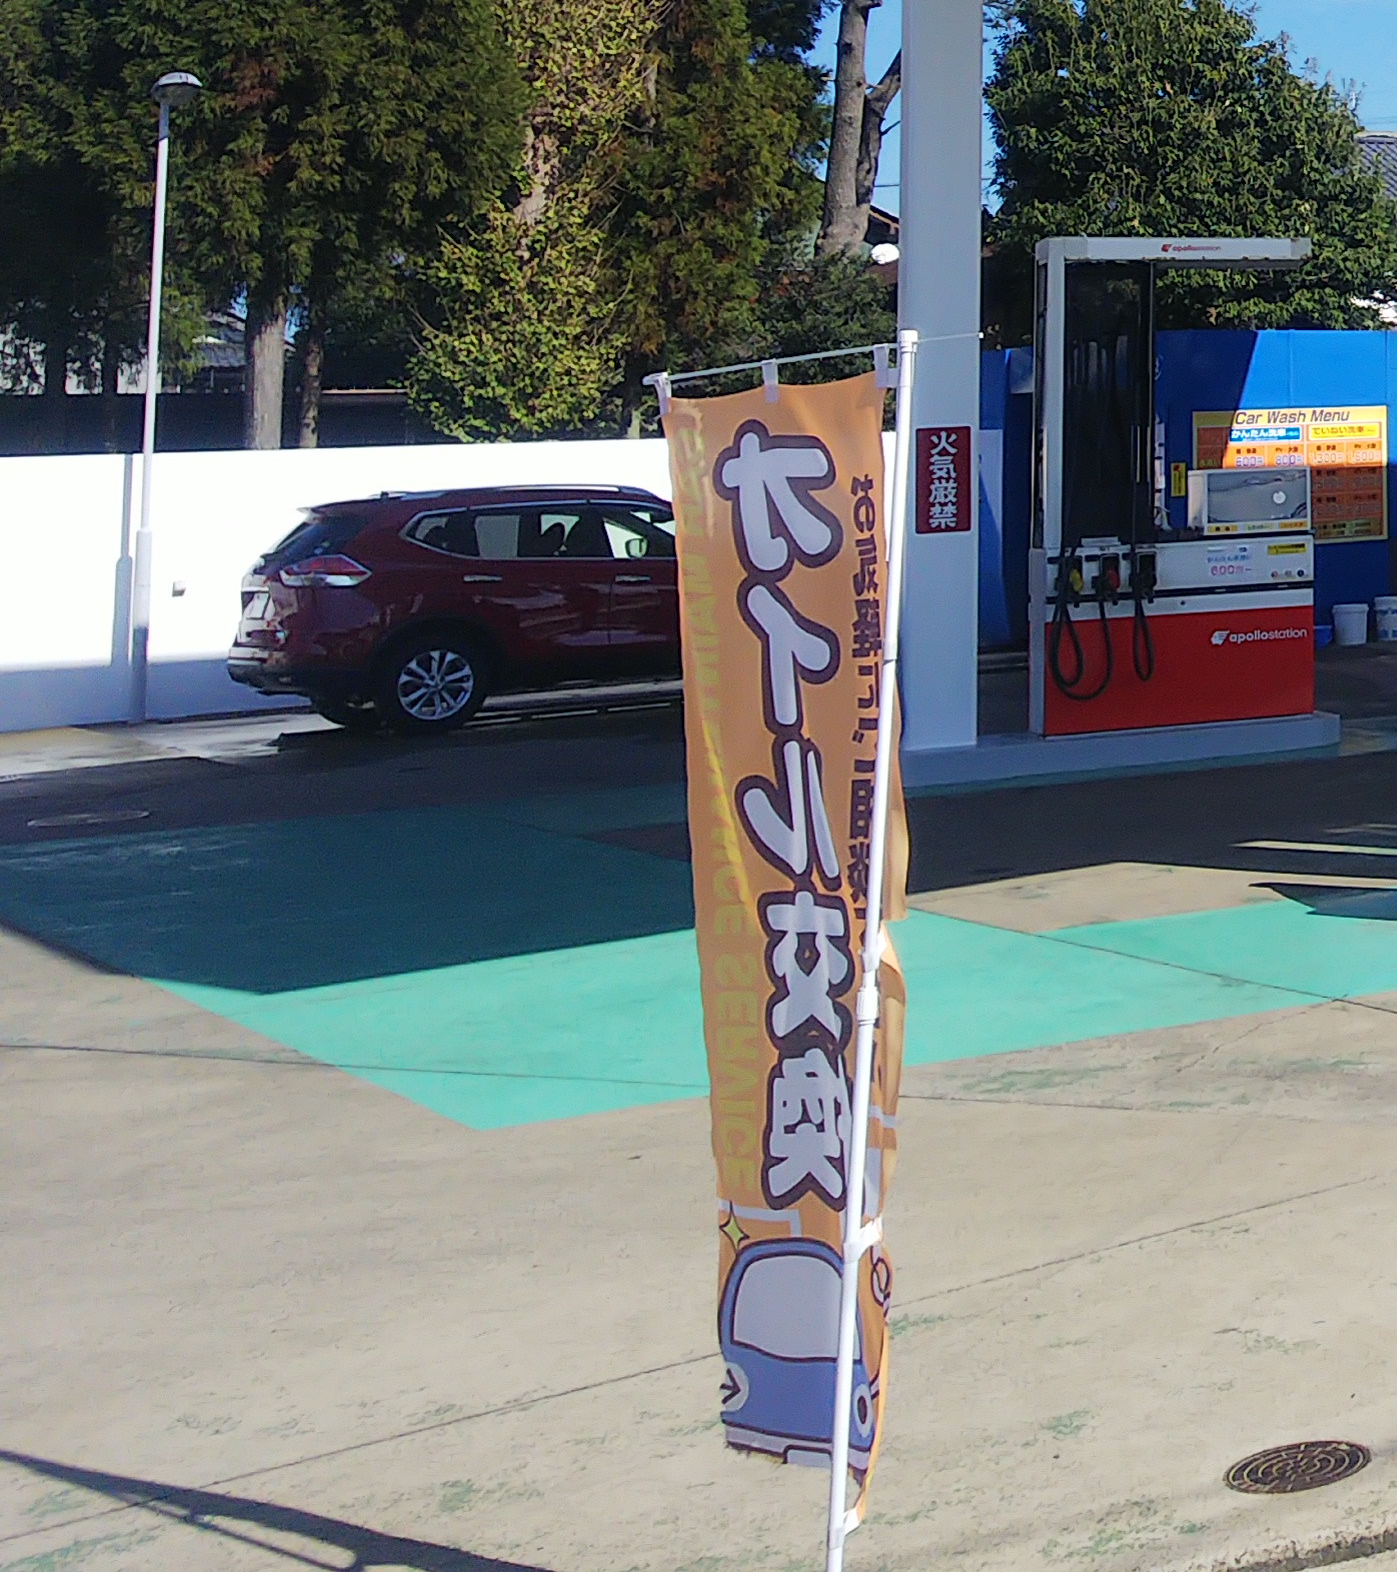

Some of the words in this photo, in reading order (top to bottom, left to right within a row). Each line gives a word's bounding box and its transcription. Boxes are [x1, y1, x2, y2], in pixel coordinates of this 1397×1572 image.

[1235, 411, 1263, 426] Car
[1266, 409, 1307, 424] Wash
[1310, 409, 1351, 423] Menu
[928, 431, 959, 530] 火気厳禁
[1229, 627, 1308, 645] apollostation
